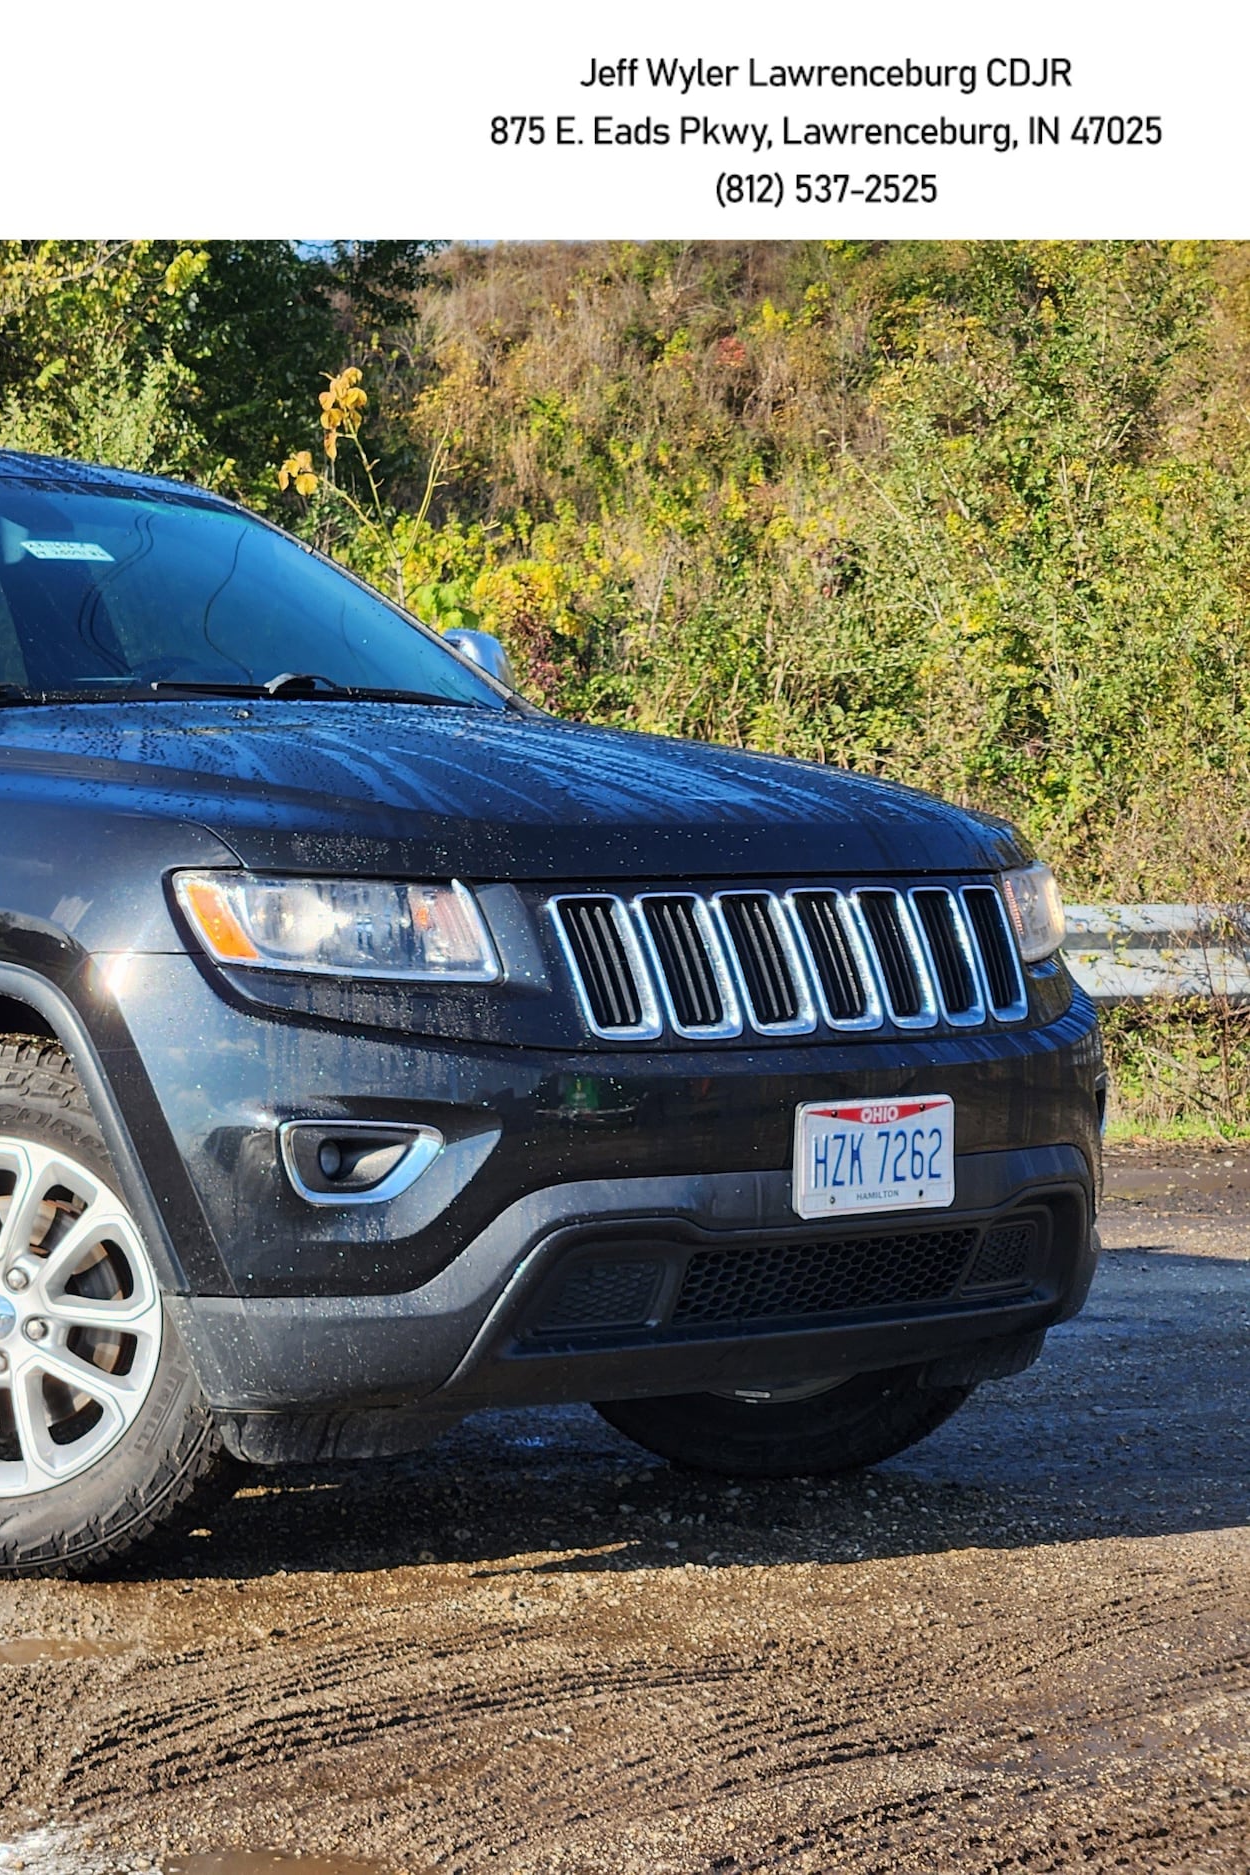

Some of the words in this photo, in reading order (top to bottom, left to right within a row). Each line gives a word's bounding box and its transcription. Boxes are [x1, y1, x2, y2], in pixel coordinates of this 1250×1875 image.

[861, 1106, 899, 1123] OHIO
[813, 1132, 864, 1188] HZK
[877, 1128, 942, 1184] 7262
[856, 1190, 899, 1201] HAMILTON
